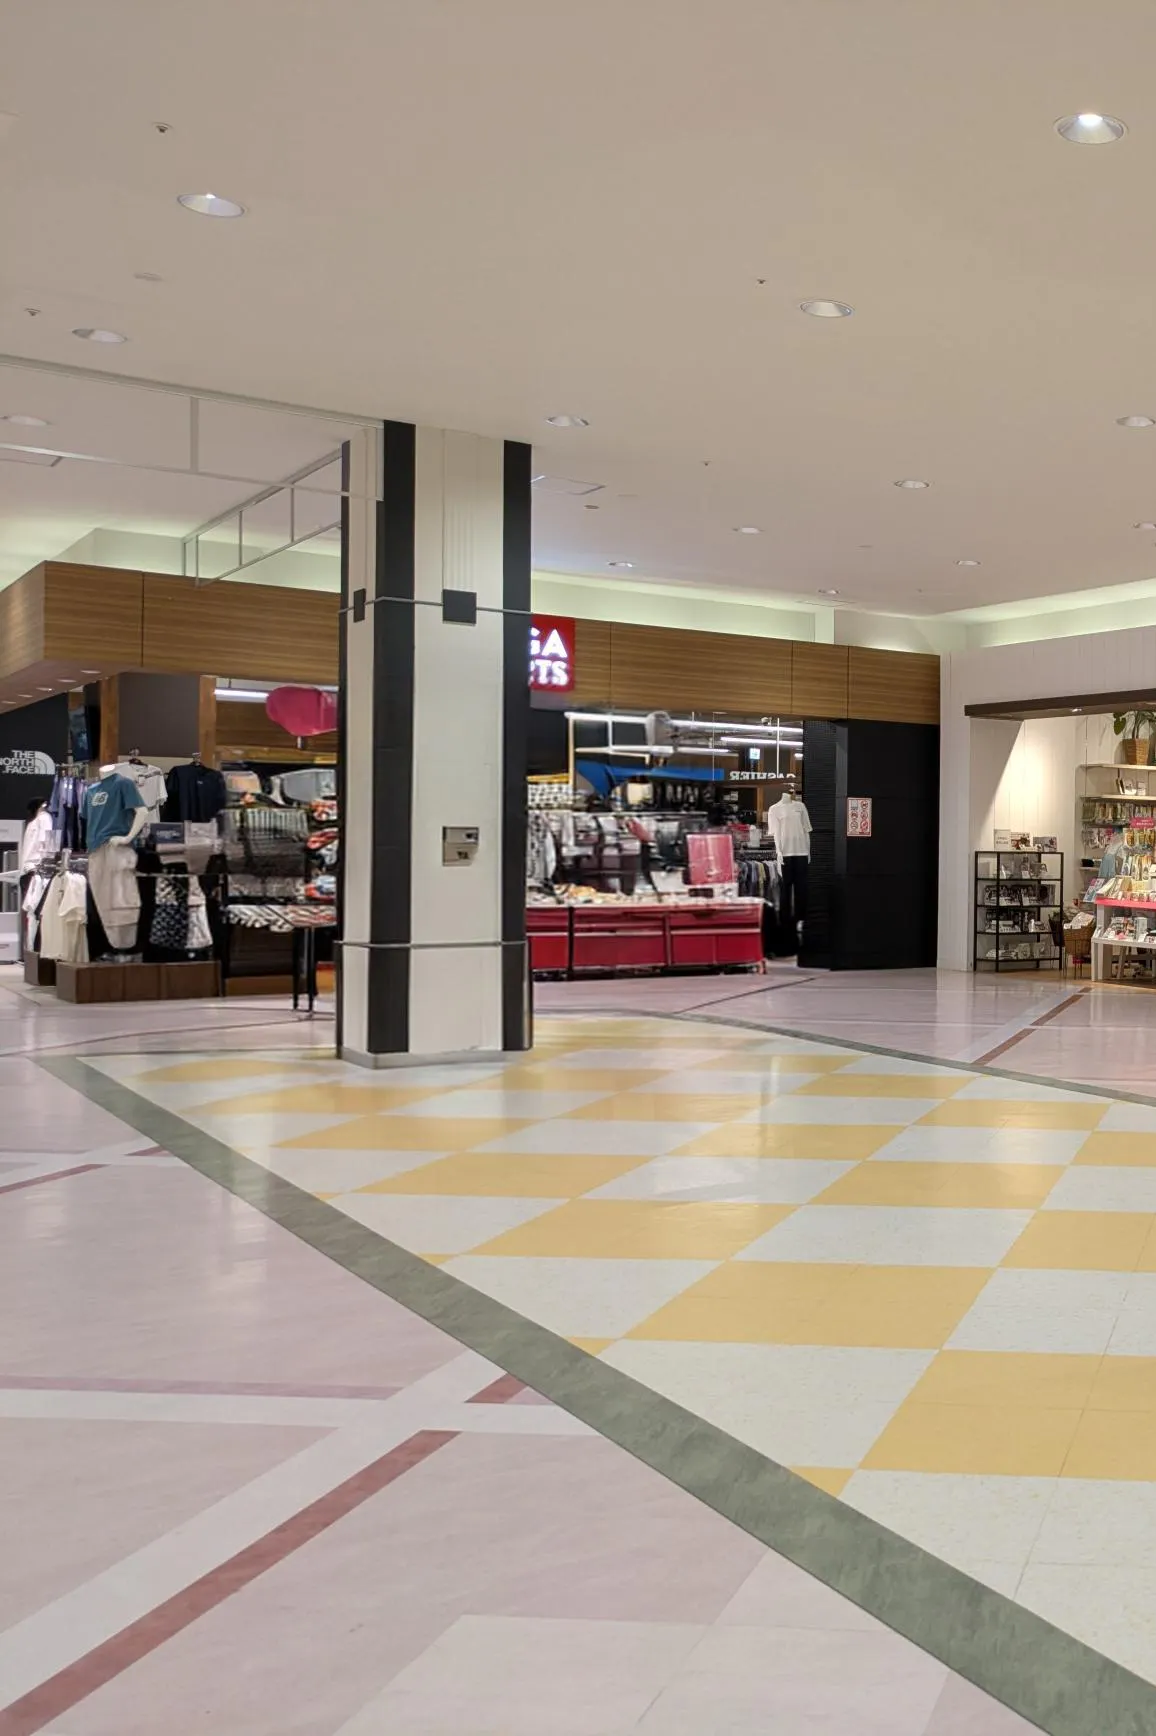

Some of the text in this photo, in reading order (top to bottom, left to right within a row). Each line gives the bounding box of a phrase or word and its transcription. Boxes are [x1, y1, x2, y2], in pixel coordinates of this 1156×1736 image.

[529, 658, 570, 686] TS
[12, 750, 35, 758] THE
[5, 766, 35, 774] FACE
